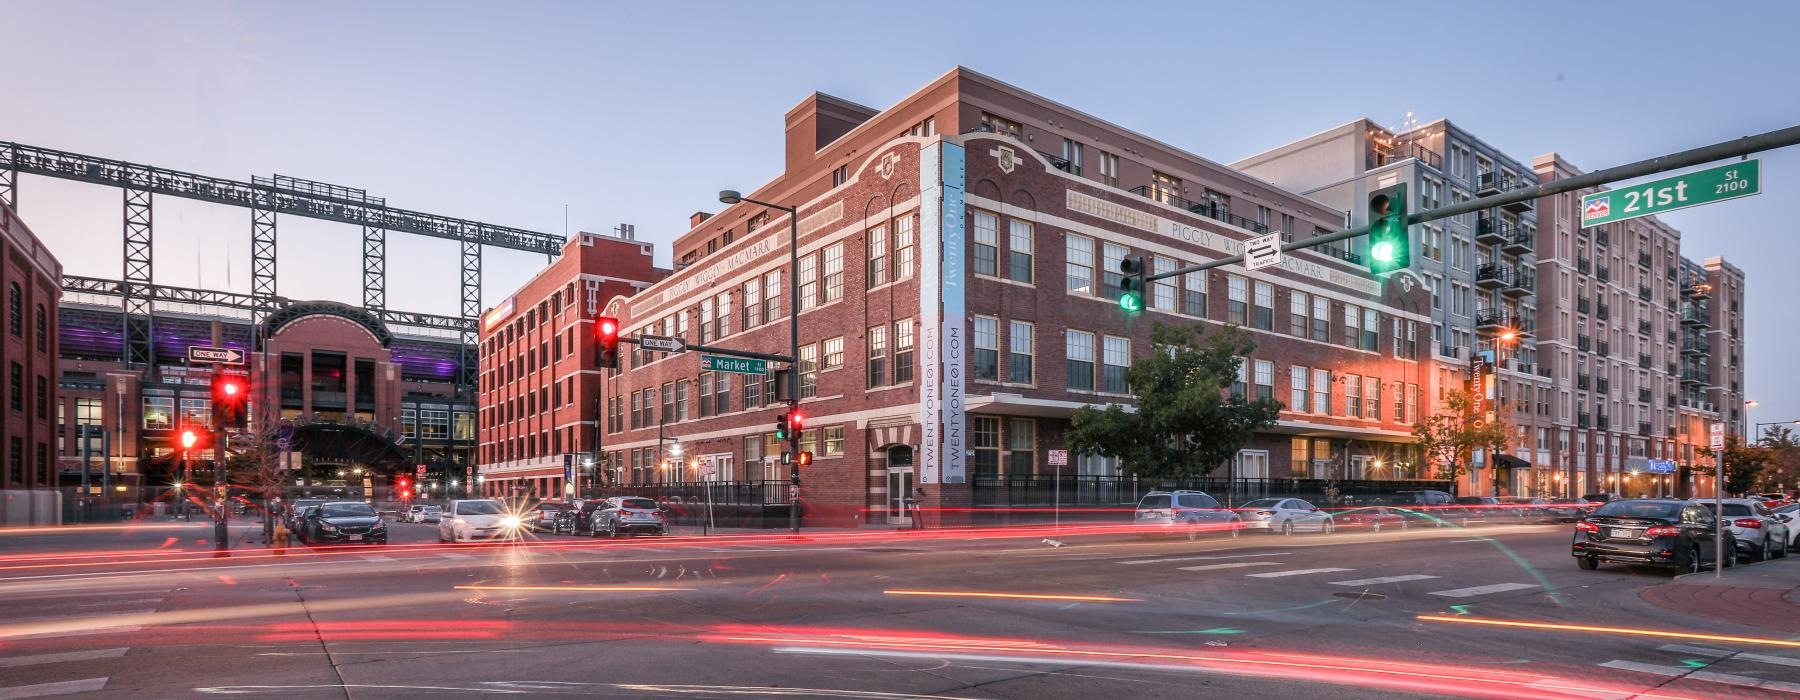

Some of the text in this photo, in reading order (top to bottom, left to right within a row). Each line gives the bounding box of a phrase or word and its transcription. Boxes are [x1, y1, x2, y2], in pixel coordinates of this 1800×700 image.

[1725, 169, 1738, 181] St
[1715, 179, 1748, 194] 2100
[1623, 180, 1688, 213] 21st
[727, 239, 770, 271] MACMARR
[1253, 258, 1274, 267] TRAFFIC
[196, 350, 210, 358] ONE
[716, 359, 750, 371] Market
